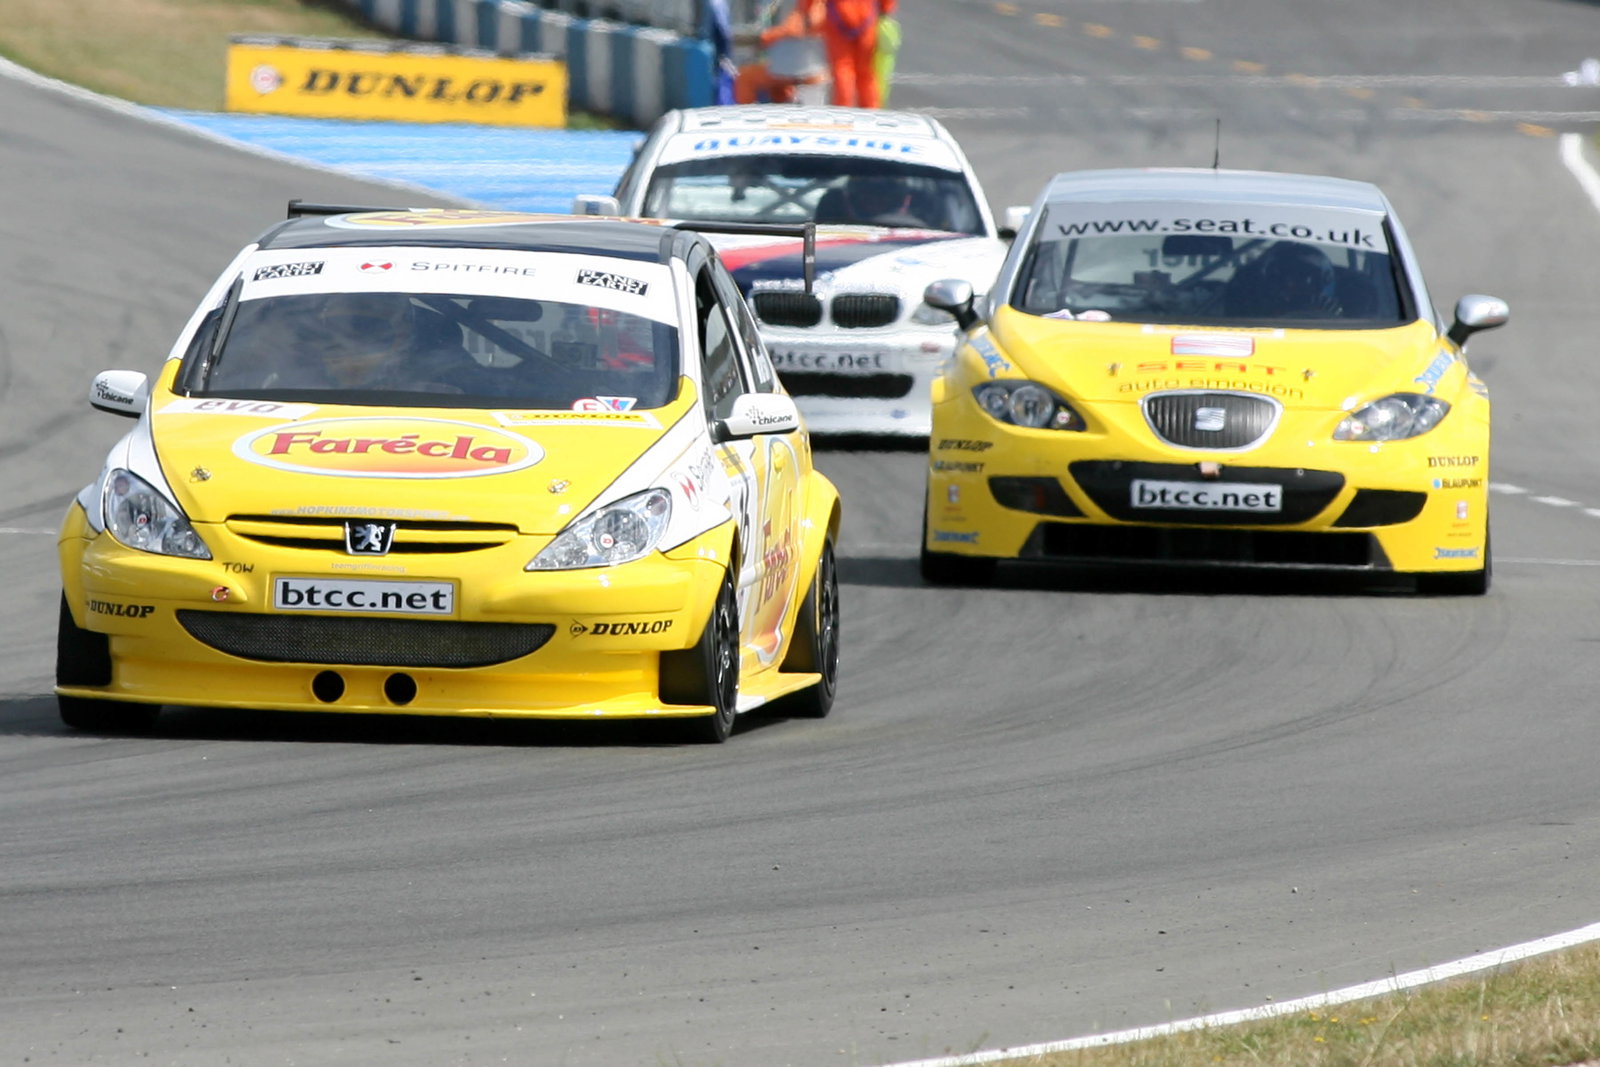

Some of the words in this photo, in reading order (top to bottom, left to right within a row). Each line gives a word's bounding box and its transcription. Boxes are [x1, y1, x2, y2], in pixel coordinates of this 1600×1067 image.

[301, 69, 545, 104] DUNLOP
[694, 136, 922, 154] QUAYSIDE
[1058, 216, 1375, 249] www.seat.co.uk
[257, 261, 324, 275] PLANET
[411, 261, 536, 277] SPITFIRE
[580, 270, 648, 288] PLANET
[582, 277, 640, 295] EARTH
[770, 348, 884, 370] btcc.net
[1137, 360, 1287, 376] SEAT
[1119, 378, 1181, 393] auto
[101, 391, 134, 405] chicane
[758, 414, 793, 426] chicane
[267, 431, 512, 464] Farécla
[1427, 456, 1479, 468] DUNLOP
[1442, 478, 1482, 489] BLAUPUNKT
[1139, 484, 1276, 507] btcc.net
[222, 562, 254, 574] TOW
[281, 581, 448, 610] btcc.net
[89, 600, 155, 618] DUNLOP
[590, 619, 673, 636] DUNLOP
